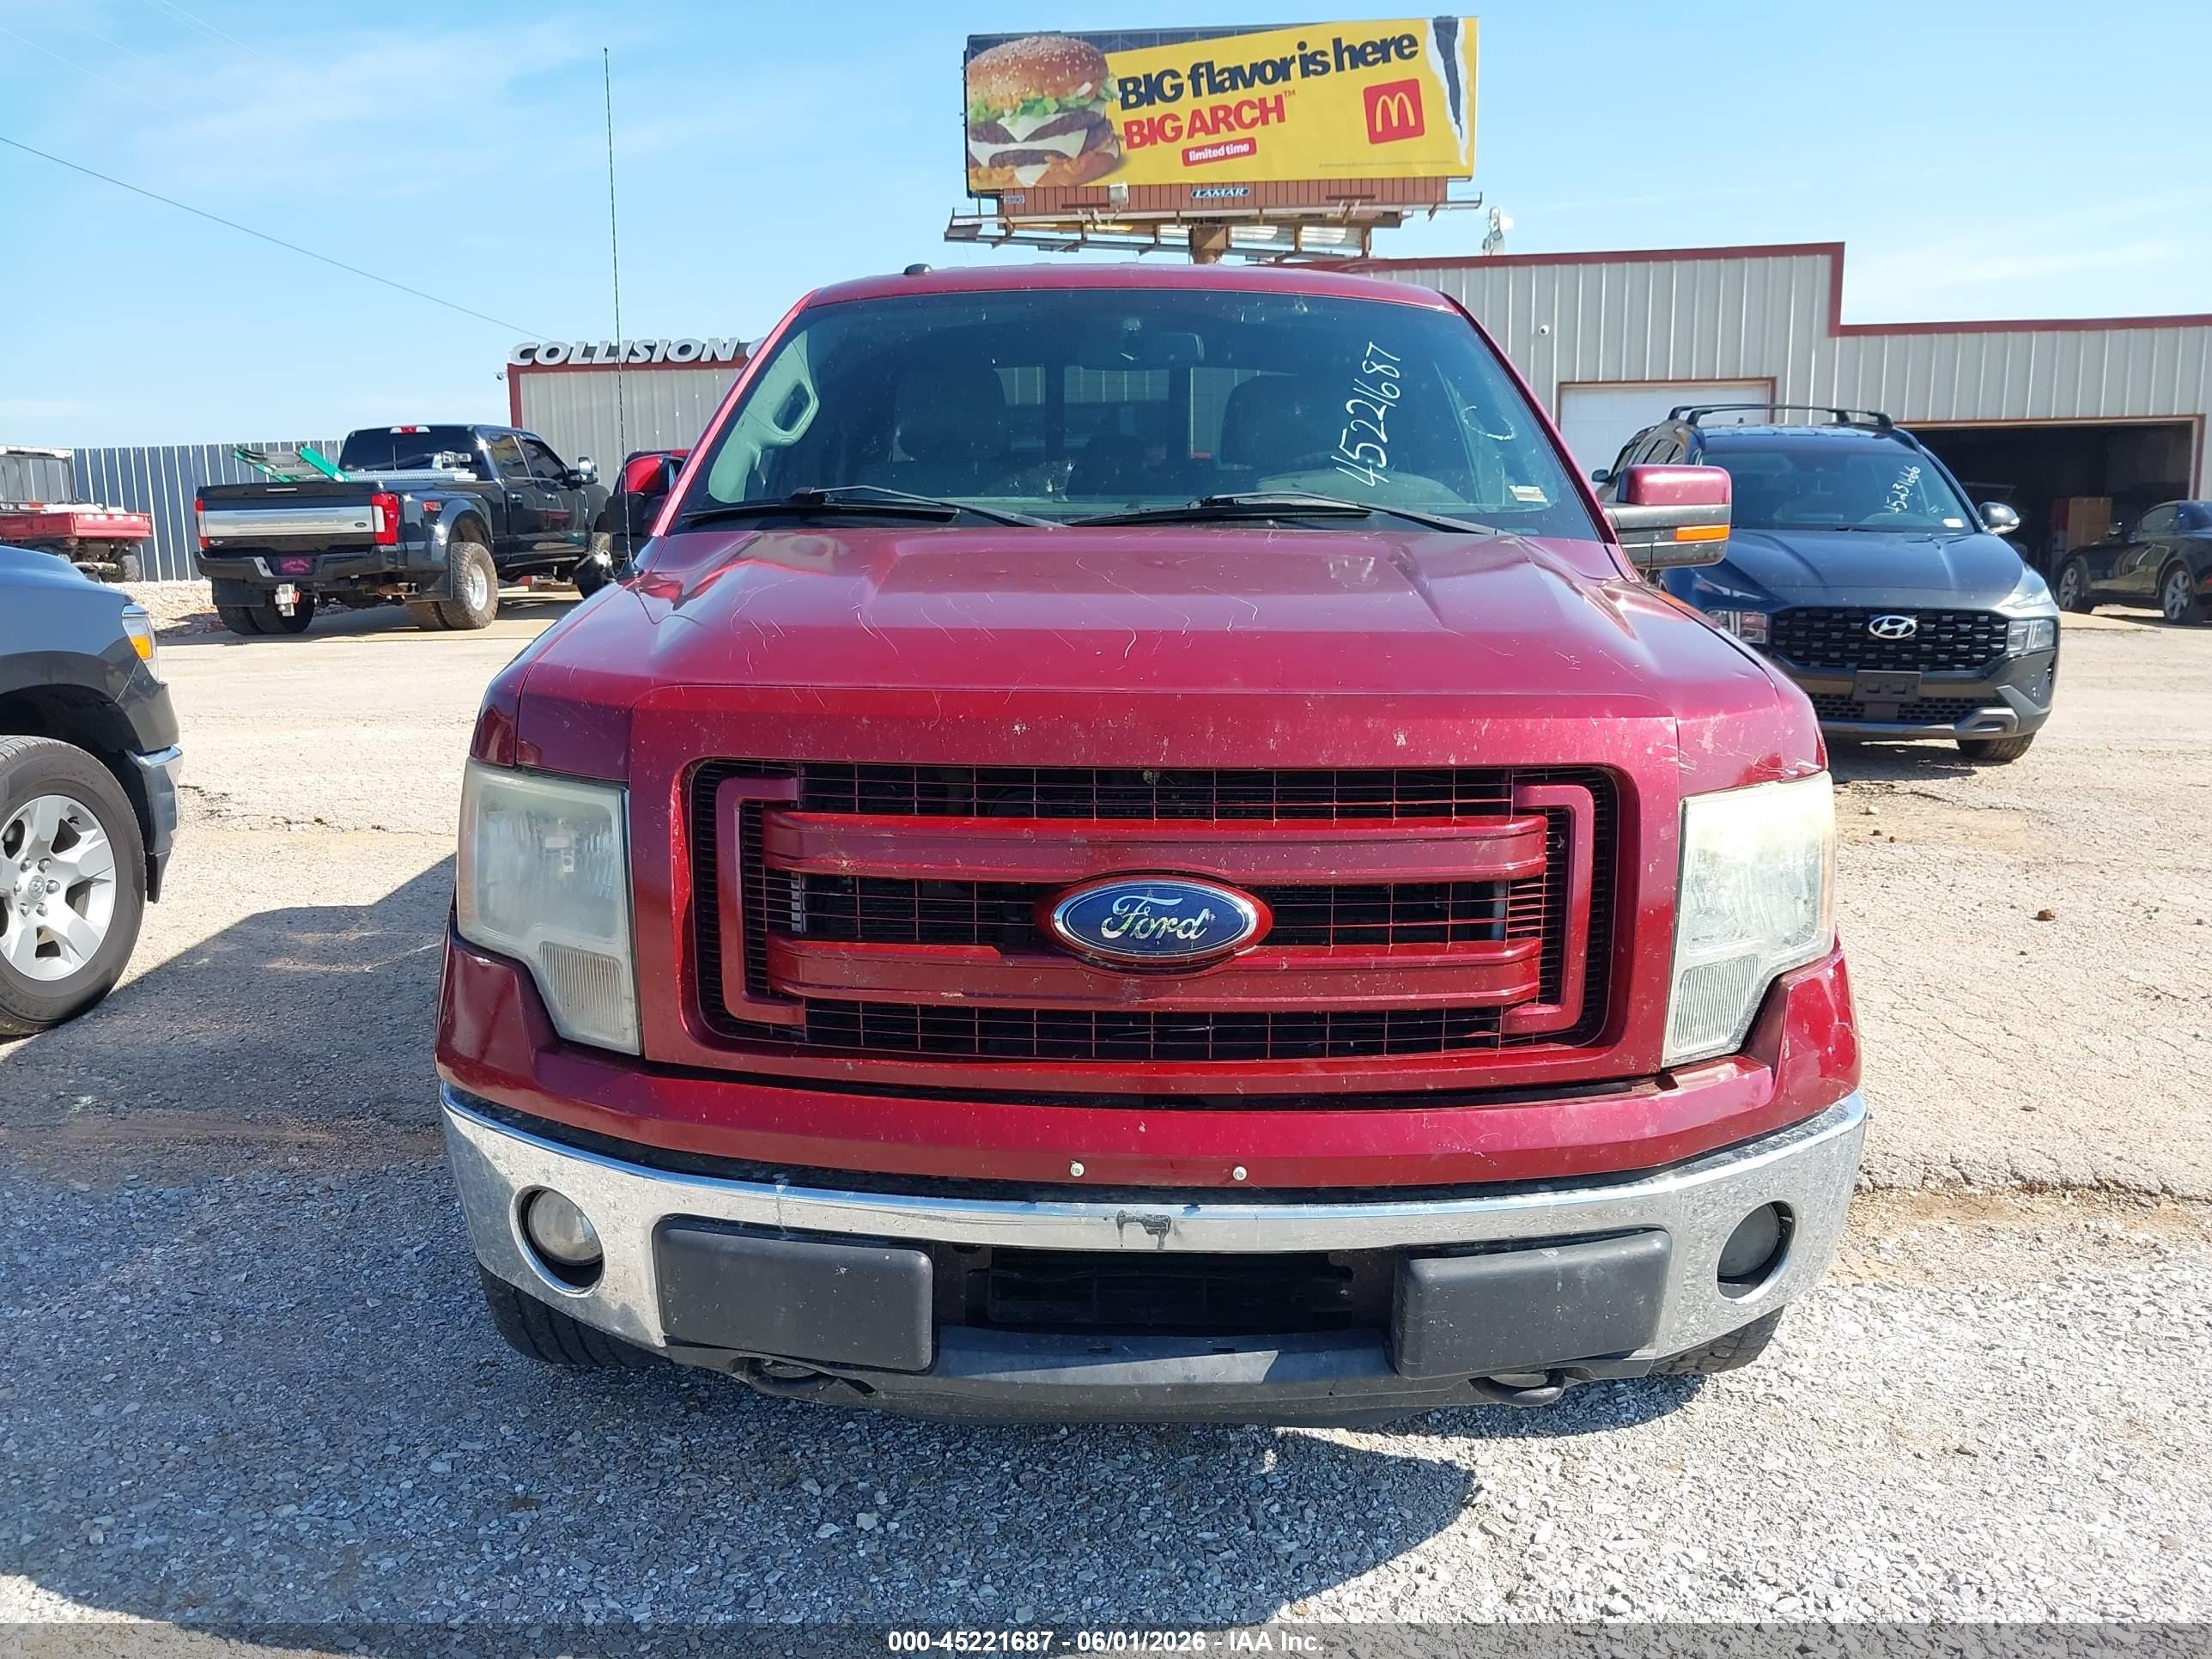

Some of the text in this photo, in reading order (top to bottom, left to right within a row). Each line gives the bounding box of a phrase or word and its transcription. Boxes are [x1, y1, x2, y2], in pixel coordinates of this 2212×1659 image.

[1117, 33, 1419, 111] BIG flavor is here
[1123, 112, 1184, 150] BIG
[1188, 142, 1250, 162] limited time
[1195, 188, 1243, 198] LAMAR
[510, 338, 738, 366] COLLISION
[1331, 341, 1401, 487] 45221687
[1101, 895, 1208, 939] Ford
